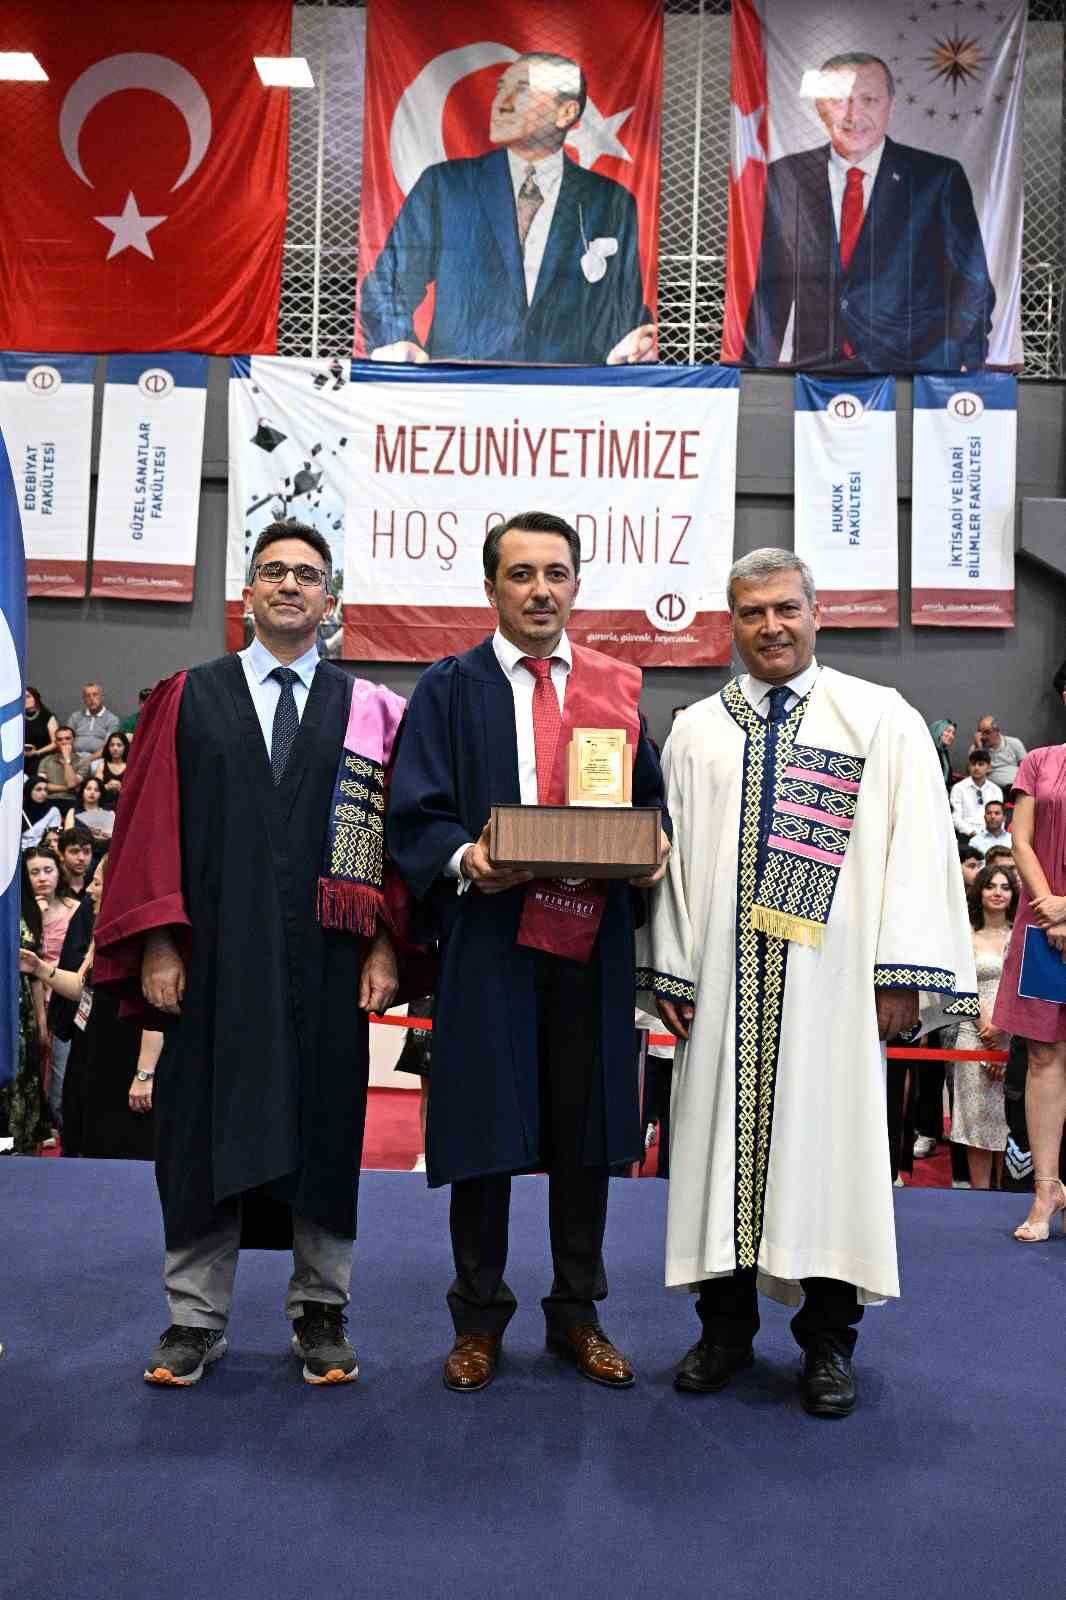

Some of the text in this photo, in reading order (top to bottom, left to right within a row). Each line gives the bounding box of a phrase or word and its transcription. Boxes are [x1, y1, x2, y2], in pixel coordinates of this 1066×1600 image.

[23, 446, 37, 511] EDEBİYAT
[40, 442, 55, 515] FAKÜLTESİ
[130, 422, 150, 541] GÜZEL SANATLAR
[150, 446, 166, 519] FAKÜLTESİ
[375, 418, 700, 479] MEZUNİYETİMİZE
[372, 510, 458, 571] HOŞ
[831, 484, 843, 533] HUKUK
[847, 471, 861, 546] FAKÜLTESİ
[948, 446, 963, 567] İKTİSADİ VE İDARİ
[966, 436, 981, 578] BİLİMLER FAKÜLTESİ
